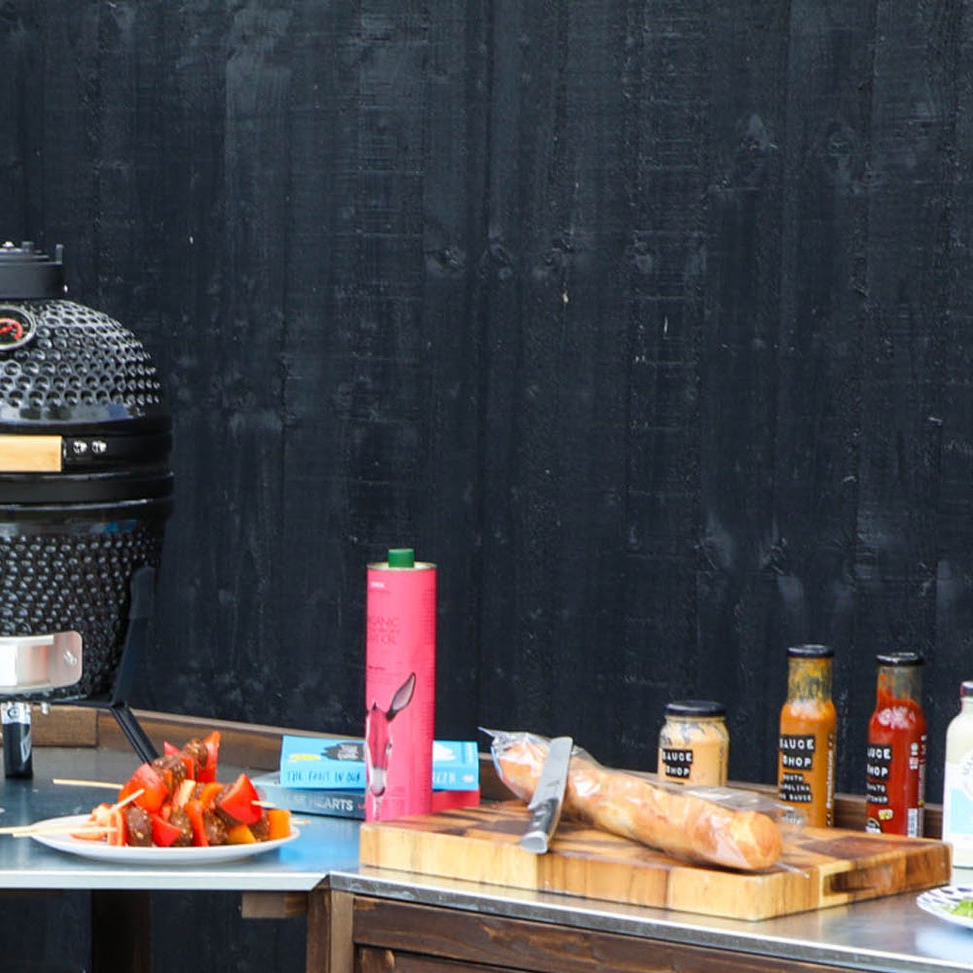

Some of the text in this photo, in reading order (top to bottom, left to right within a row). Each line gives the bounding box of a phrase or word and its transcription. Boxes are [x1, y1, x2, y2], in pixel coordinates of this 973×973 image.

[778, 737, 815, 750] SAUCE
[661, 751, 692, 762] SAUCE
[782, 754, 812, 768] SHOP
[665, 765, 690, 777] SHOP
